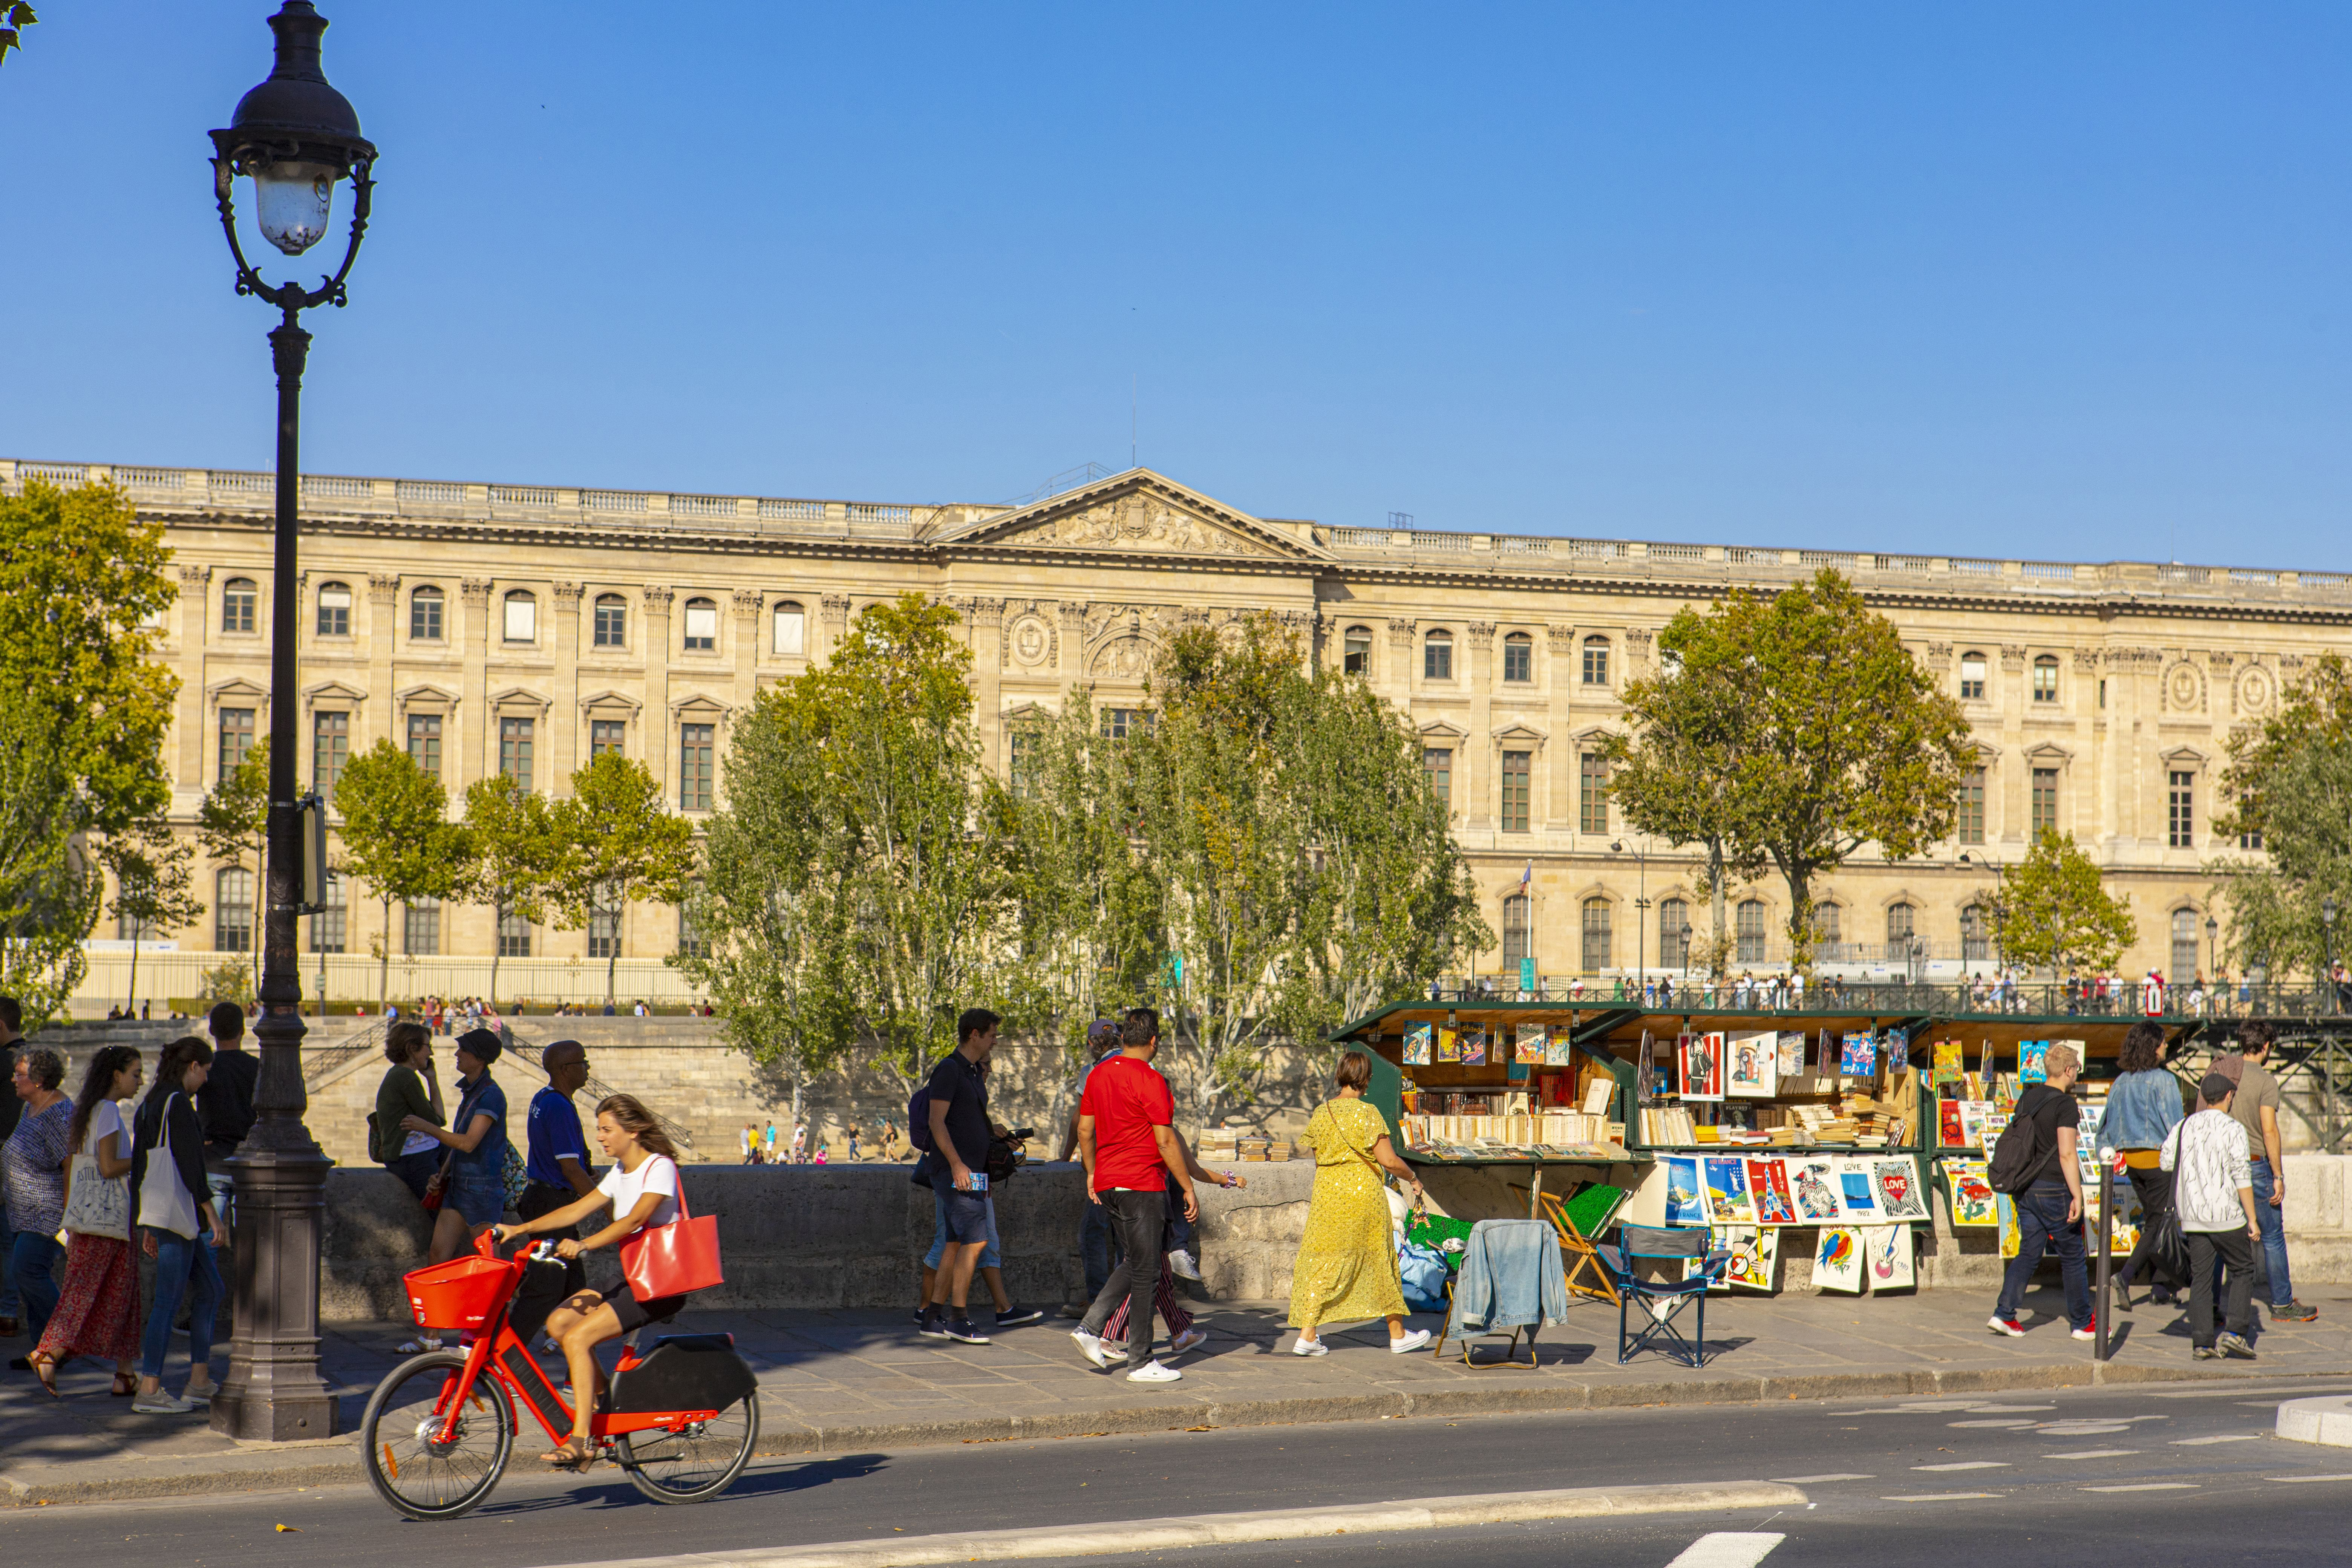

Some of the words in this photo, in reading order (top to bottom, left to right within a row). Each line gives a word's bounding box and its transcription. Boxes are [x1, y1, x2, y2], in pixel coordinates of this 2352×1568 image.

[1461, 1025, 1484, 1034] Strange
[1884, 1180, 1906, 1190] LOVE
[1825, 1224, 1846, 1234] LOVE
[1896, 1261, 1908, 1271] 1980
